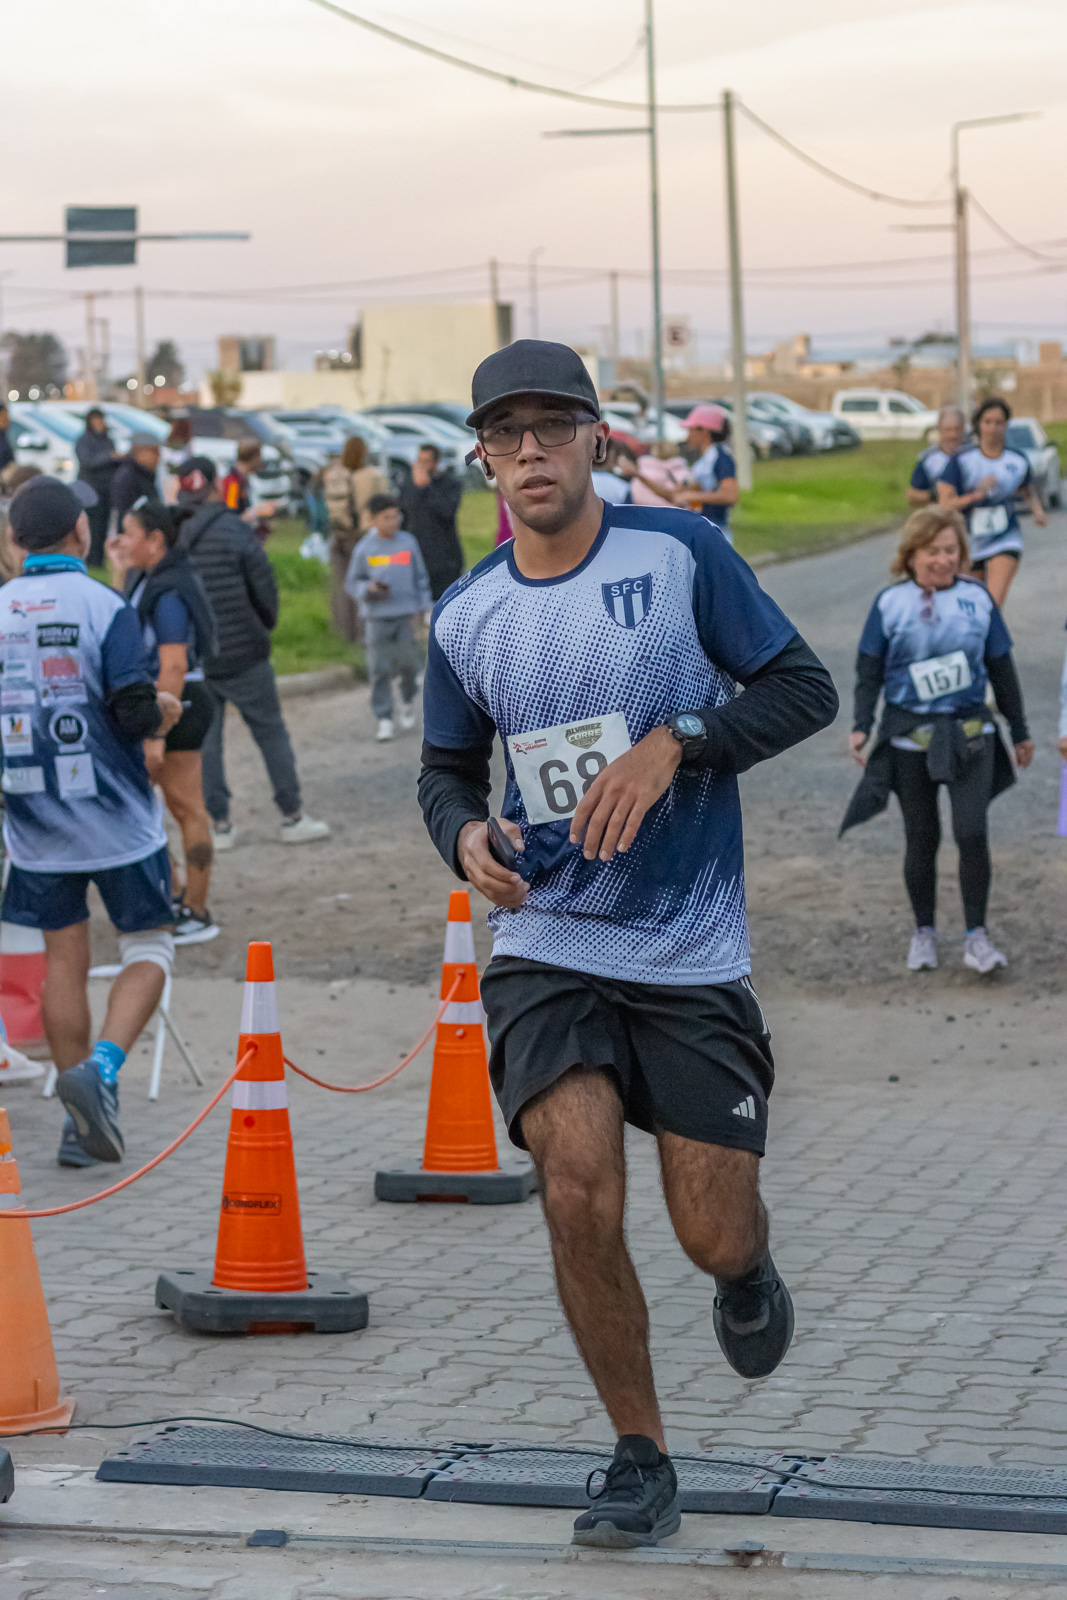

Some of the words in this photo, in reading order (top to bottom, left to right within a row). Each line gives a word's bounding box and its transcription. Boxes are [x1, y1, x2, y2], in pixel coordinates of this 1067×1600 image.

[610, 580, 644, 597] SFC
[922, 663, 963, 695] 157
[565, 722, 602, 736] ALVAREZ
[568, 730, 601, 742] CORRE
[539, 750, 609, 814] 68
